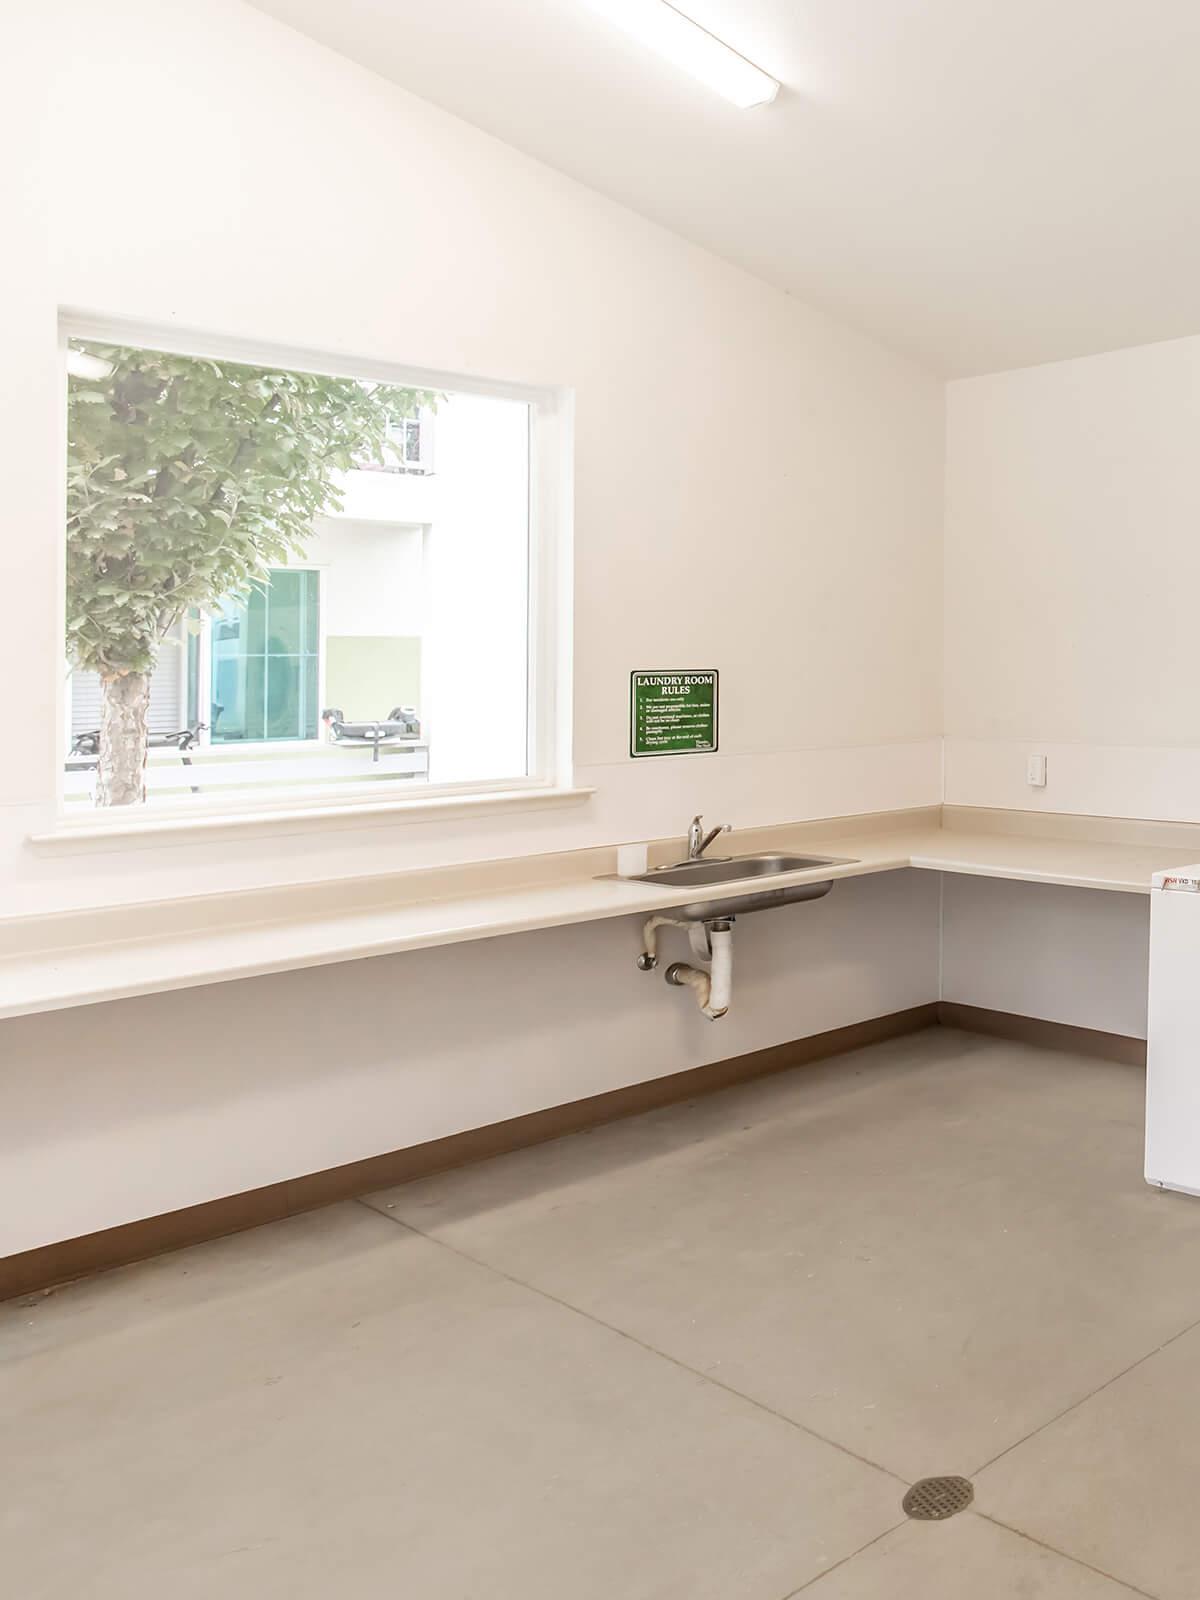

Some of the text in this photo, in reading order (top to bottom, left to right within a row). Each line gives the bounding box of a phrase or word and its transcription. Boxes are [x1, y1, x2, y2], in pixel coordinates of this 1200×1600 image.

[638, 676, 712, 686] LAUNDRY ROOM
[662, 686, 690, 695] RULES
